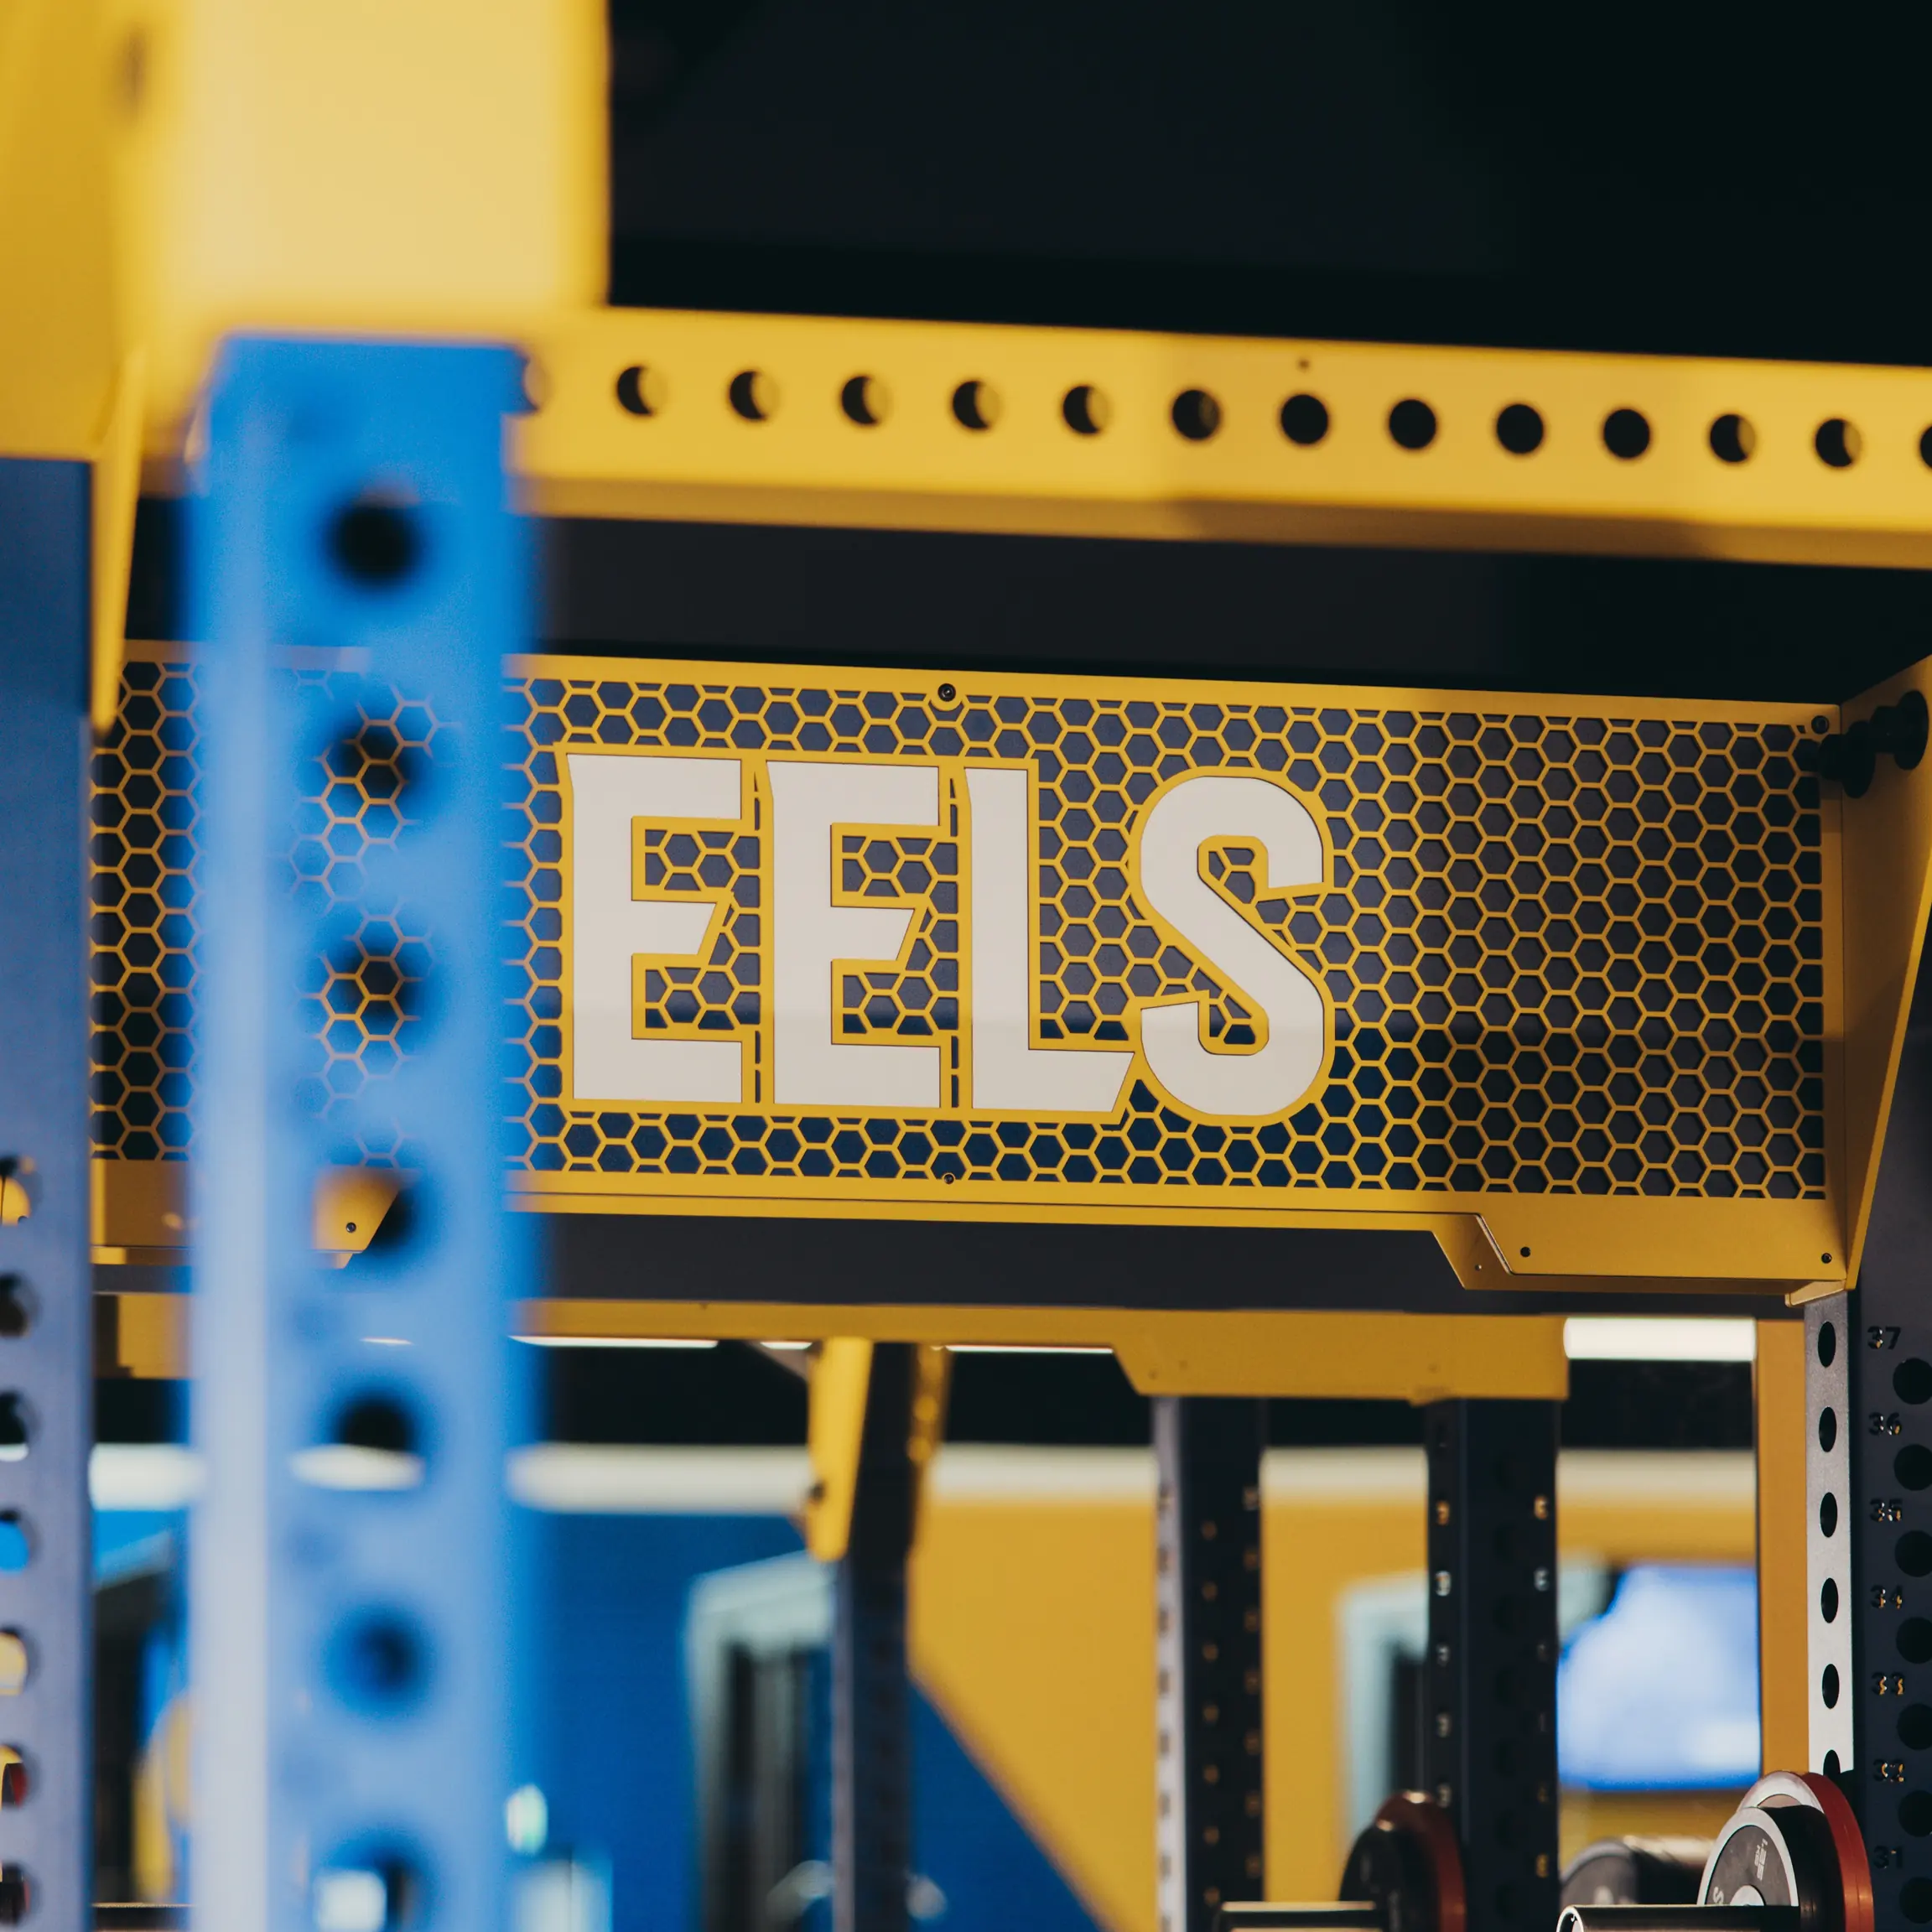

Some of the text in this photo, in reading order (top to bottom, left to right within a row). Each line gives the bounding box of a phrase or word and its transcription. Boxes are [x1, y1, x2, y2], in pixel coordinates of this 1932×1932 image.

[566, 752, 1324, 1116] EELS
[1867, 1326, 1901, 1350] 37
[1868, 1411, 1902, 1436] 36
[1870, 1498, 1903, 1523] 35
[1870, 1584, 1904, 1609] 34
[1871, 1672, 1905, 1696] 33
[1872, 1758, 1905, 1783] 32
[1873, 1845, 1904, 1869] 31
